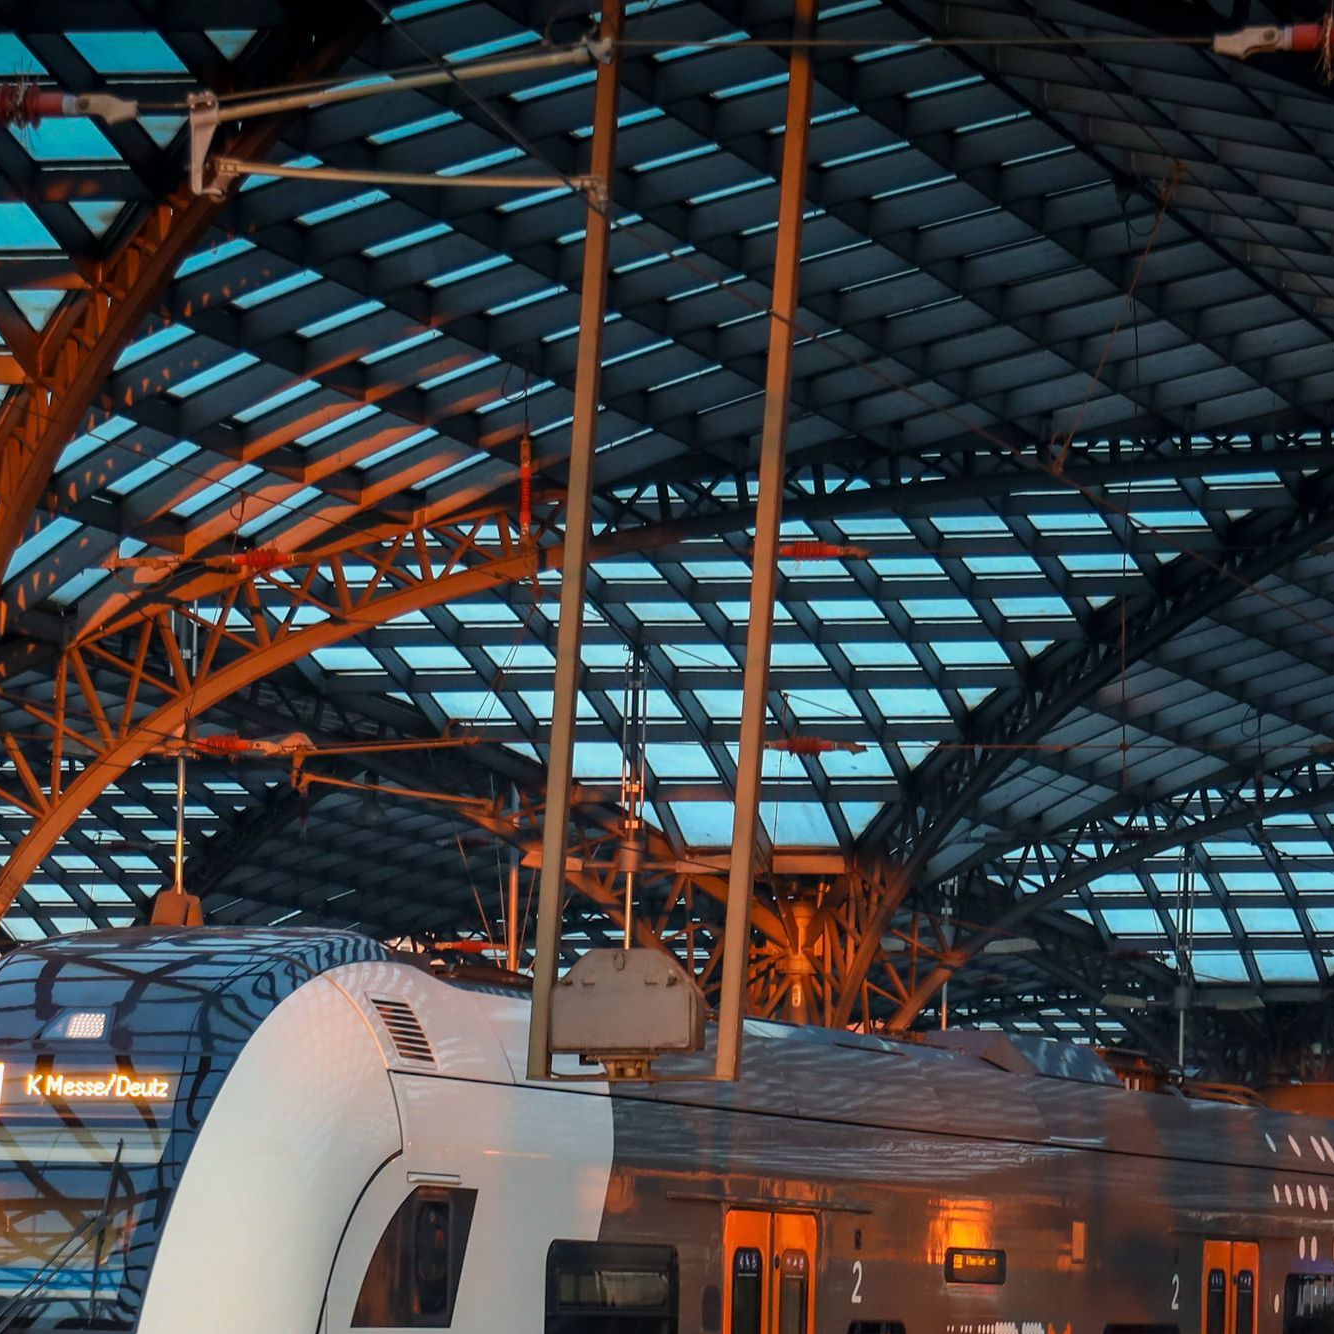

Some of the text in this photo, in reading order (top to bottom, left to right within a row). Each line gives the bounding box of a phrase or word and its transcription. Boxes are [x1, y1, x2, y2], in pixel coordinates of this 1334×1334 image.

[27, 1073, 42, 1096] K
[45, 1073, 170, 1099] Messe/Deutz
[851, 1260, 863, 1304] 2
[1171, 1273, 1180, 1311] 2
